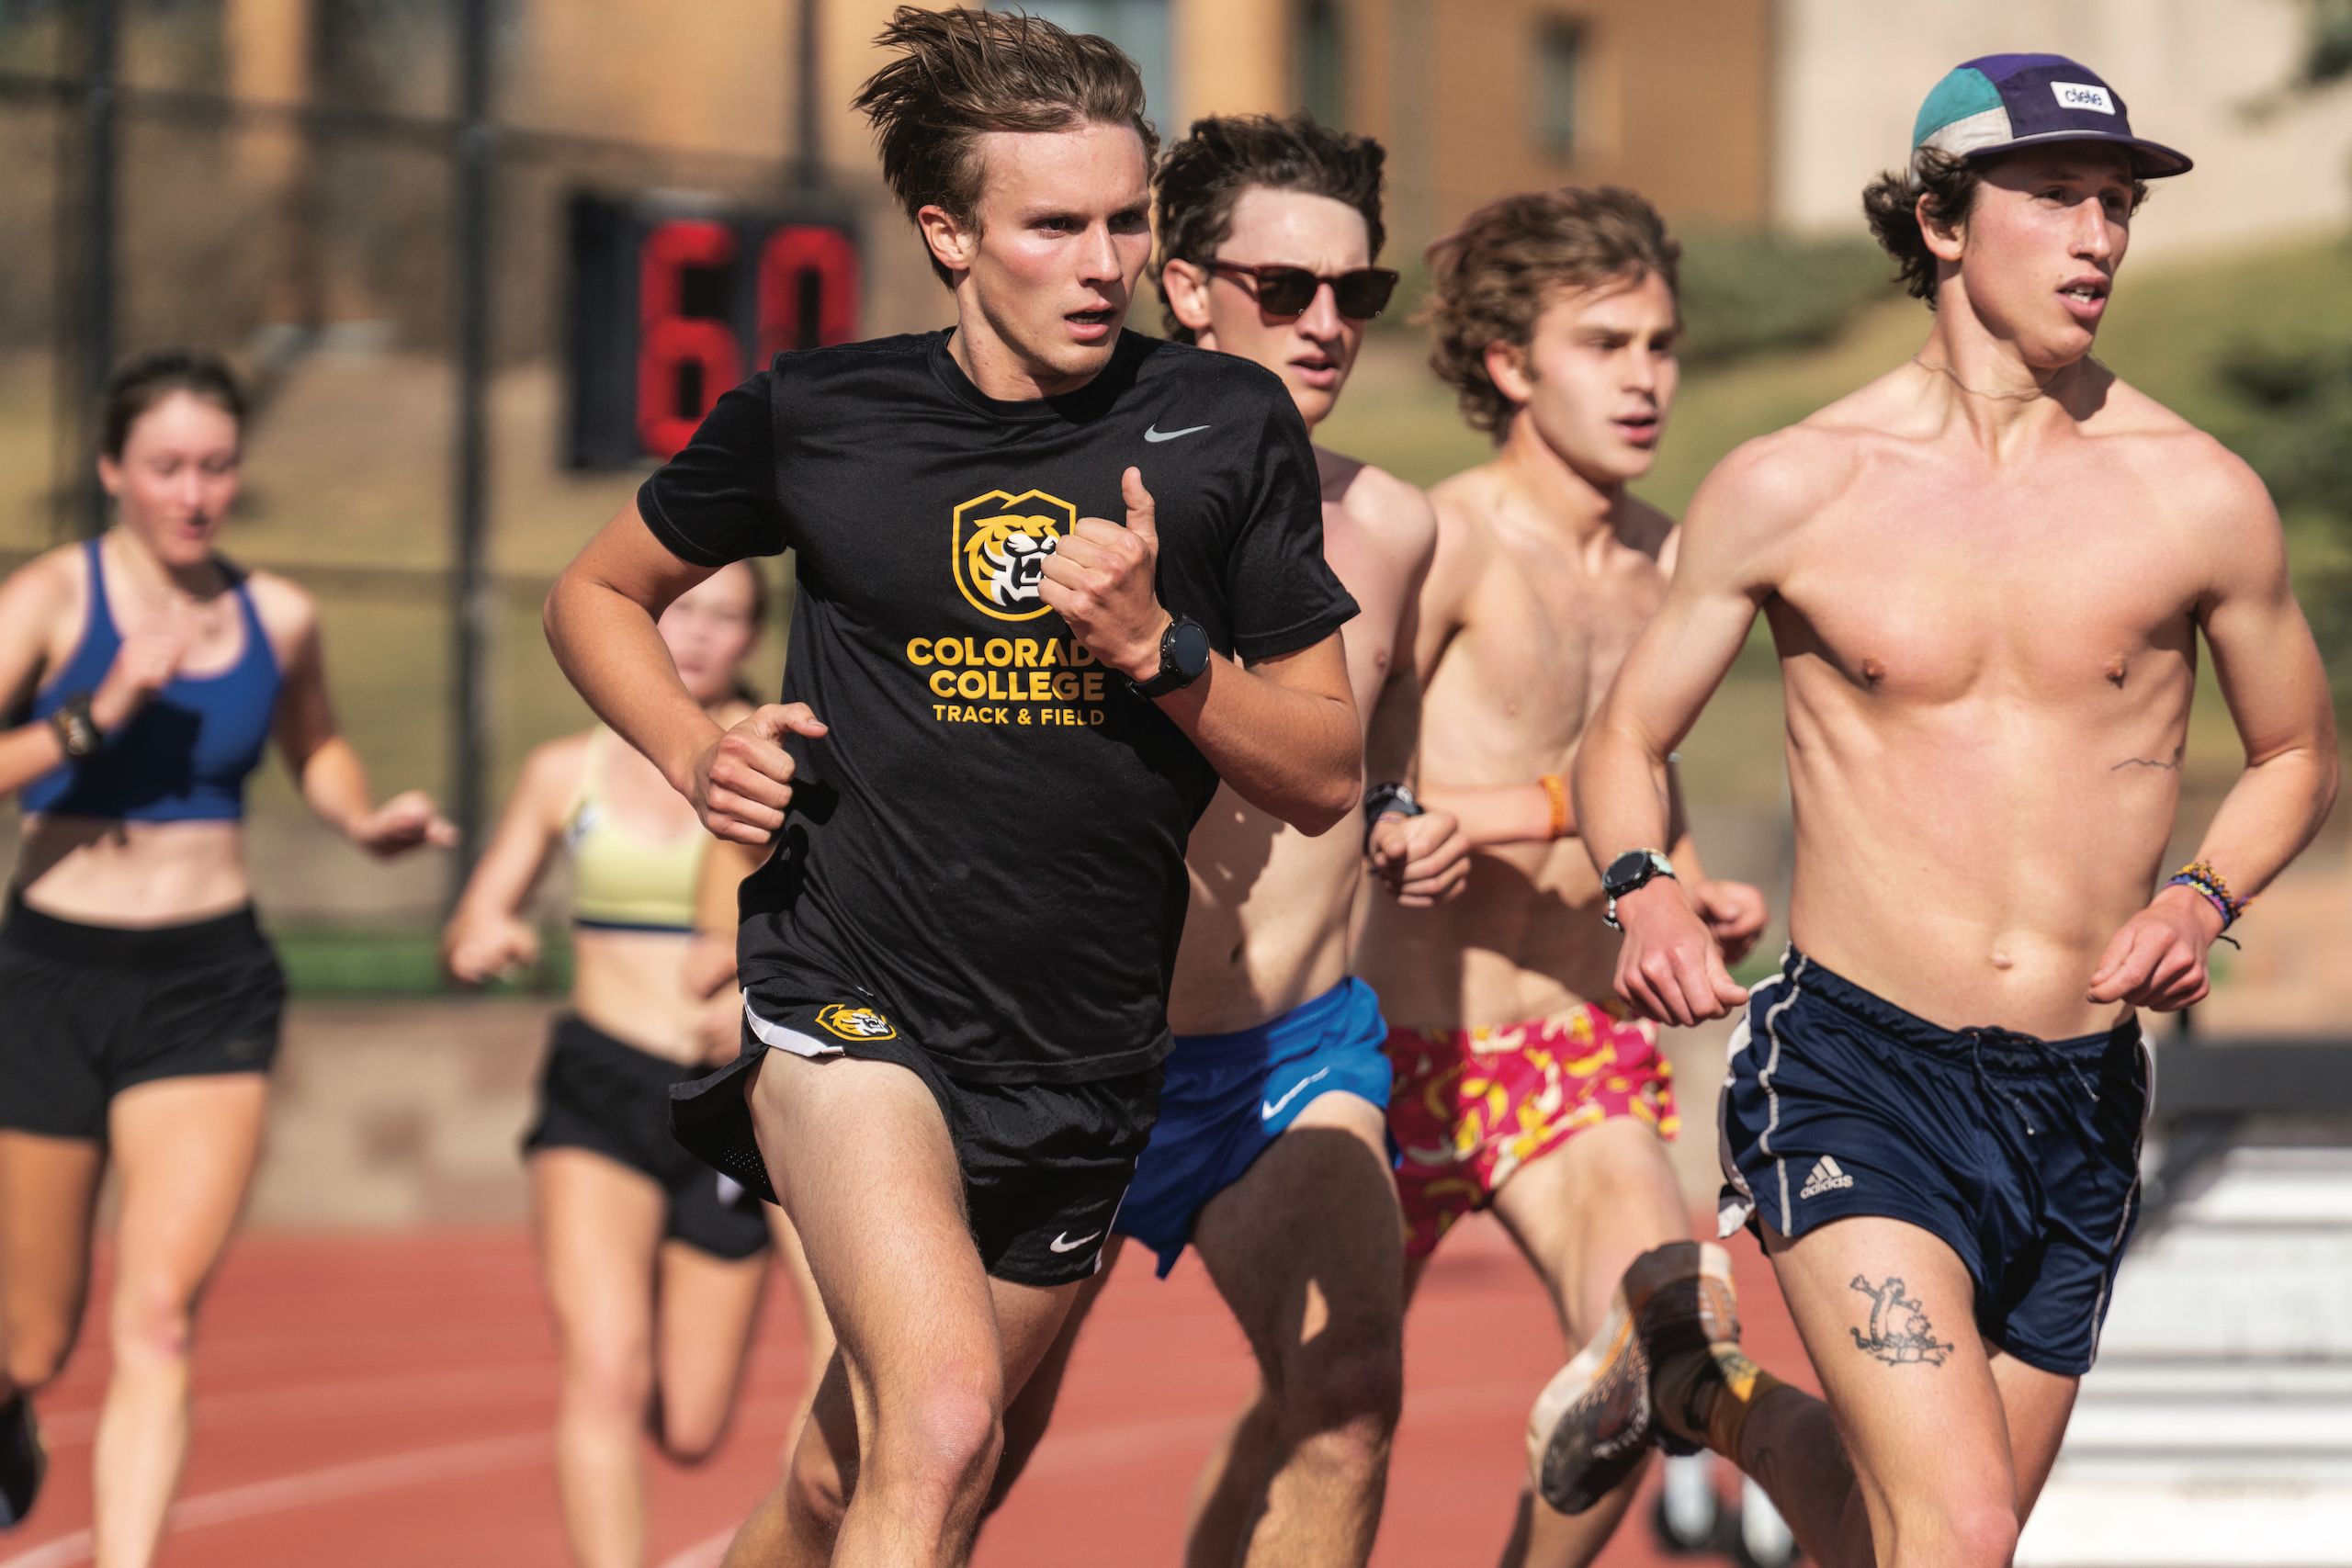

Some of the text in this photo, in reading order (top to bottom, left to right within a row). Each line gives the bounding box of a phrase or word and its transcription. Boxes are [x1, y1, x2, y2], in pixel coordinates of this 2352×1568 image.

[906, 636, 1097, 668] COLORAD
[929, 669, 1105, 702] COLLEGE
[932, 704, 1105, 727] TRACK & FIELD
[1799, 1174, 1854, 1200] adidas
